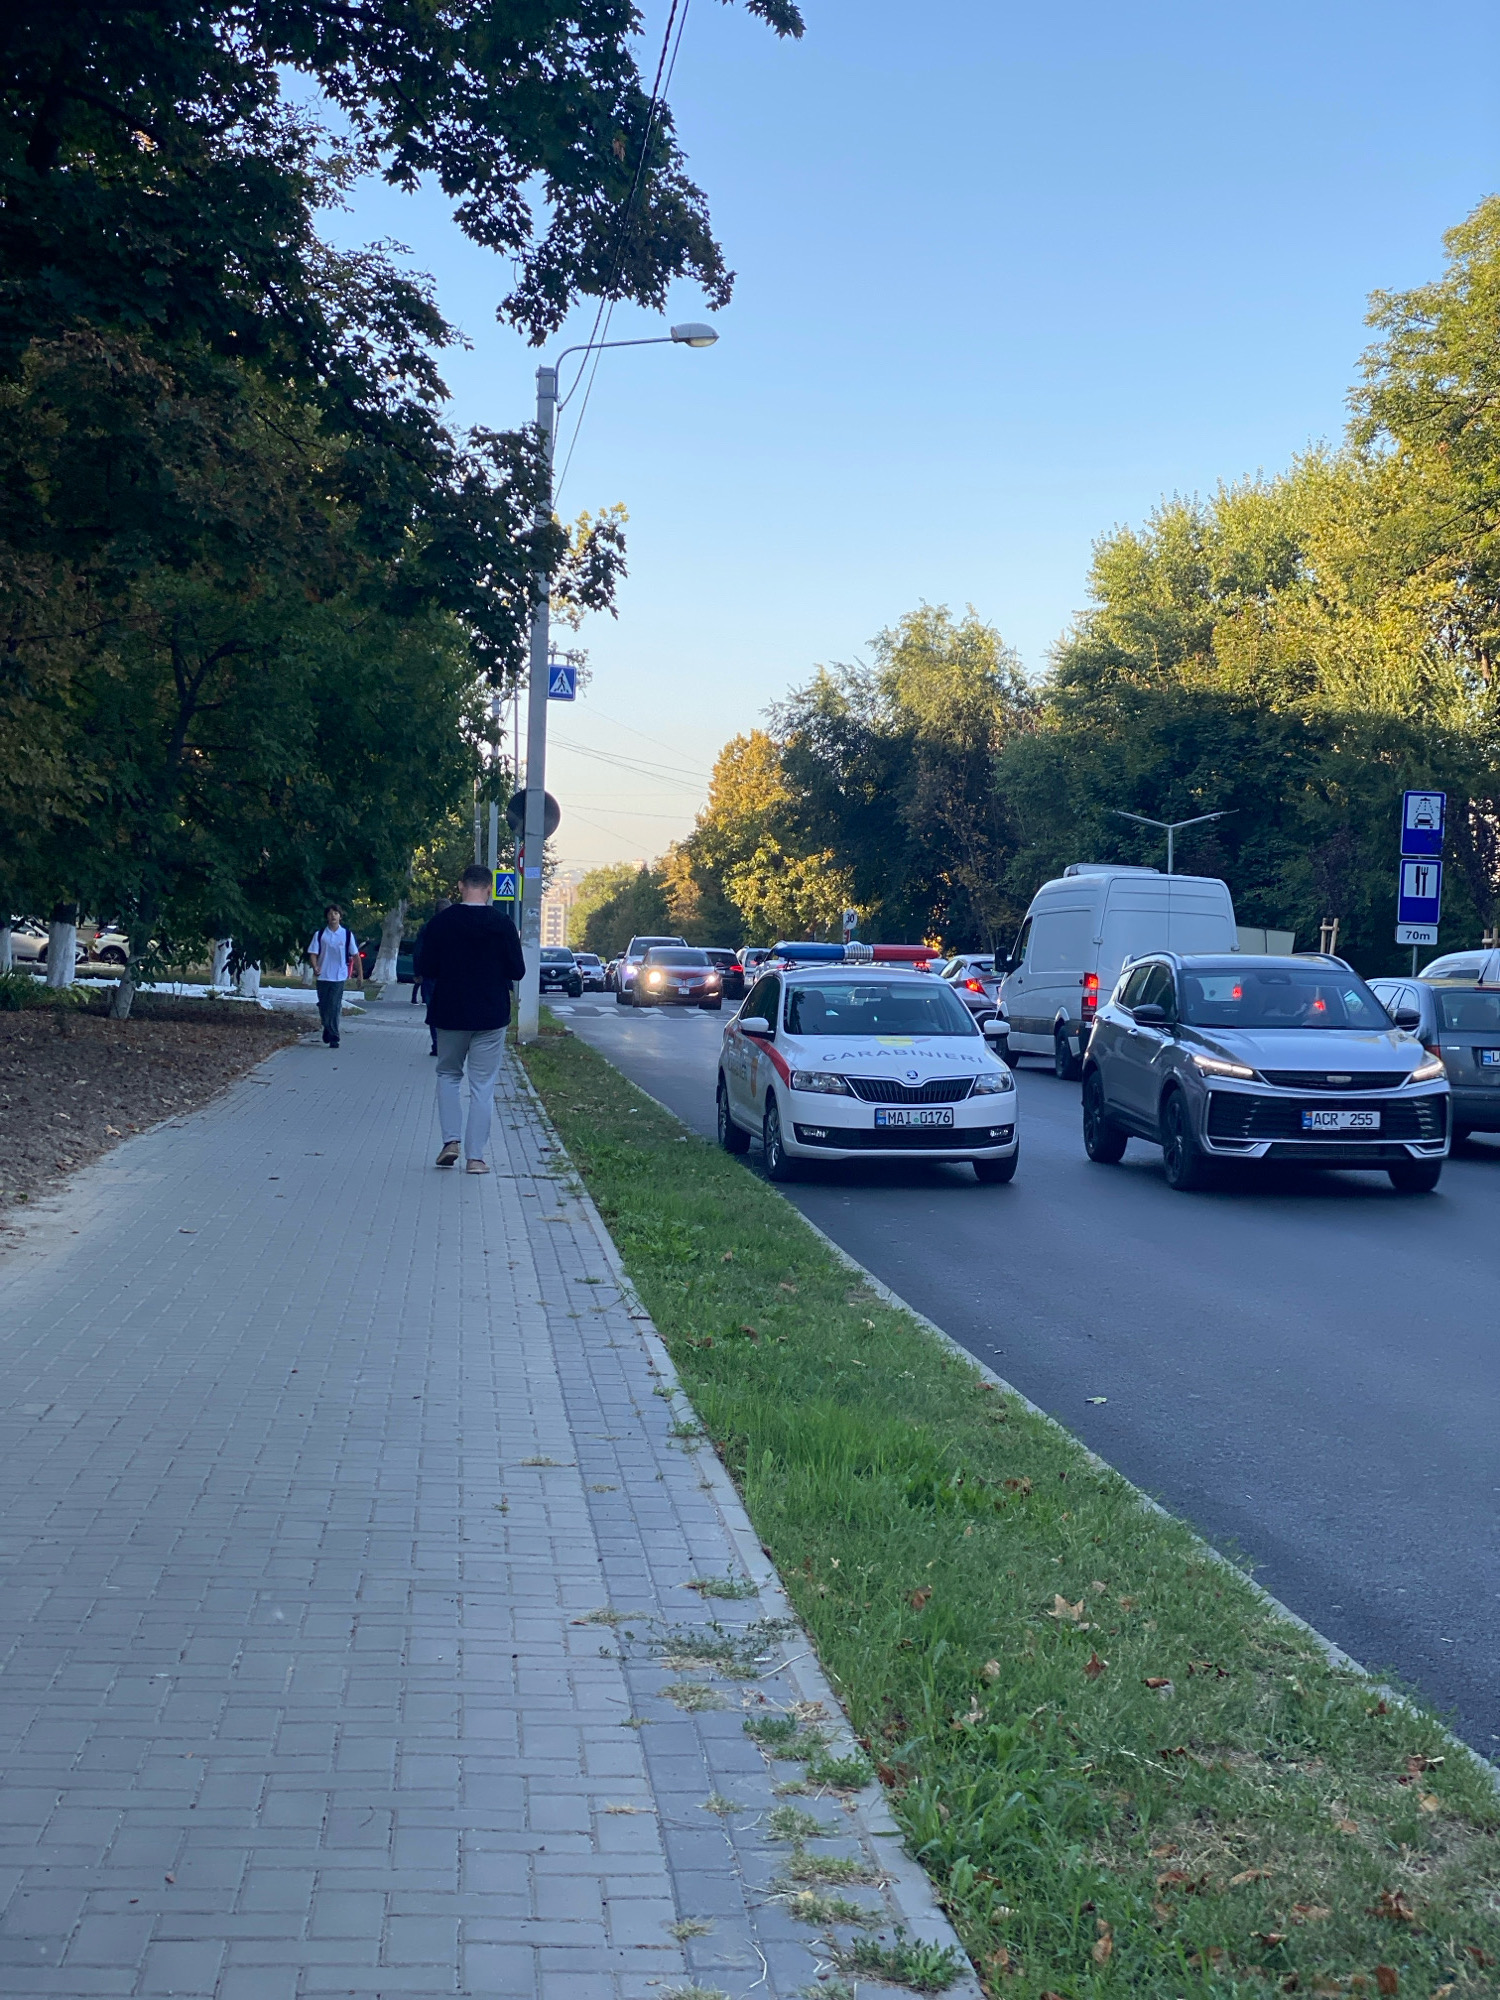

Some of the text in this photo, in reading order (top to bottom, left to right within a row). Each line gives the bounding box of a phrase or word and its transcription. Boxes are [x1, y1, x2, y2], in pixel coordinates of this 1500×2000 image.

[1405, 930, 1431, 940] 70m
[821, 1049, 984, 1064] CARABINIERI
[888, 1111, 951, 1125] MAI 0176
[1313, 1112, 1339, 1126] ACR
[1349, 1113, 1374, 1126] 255
